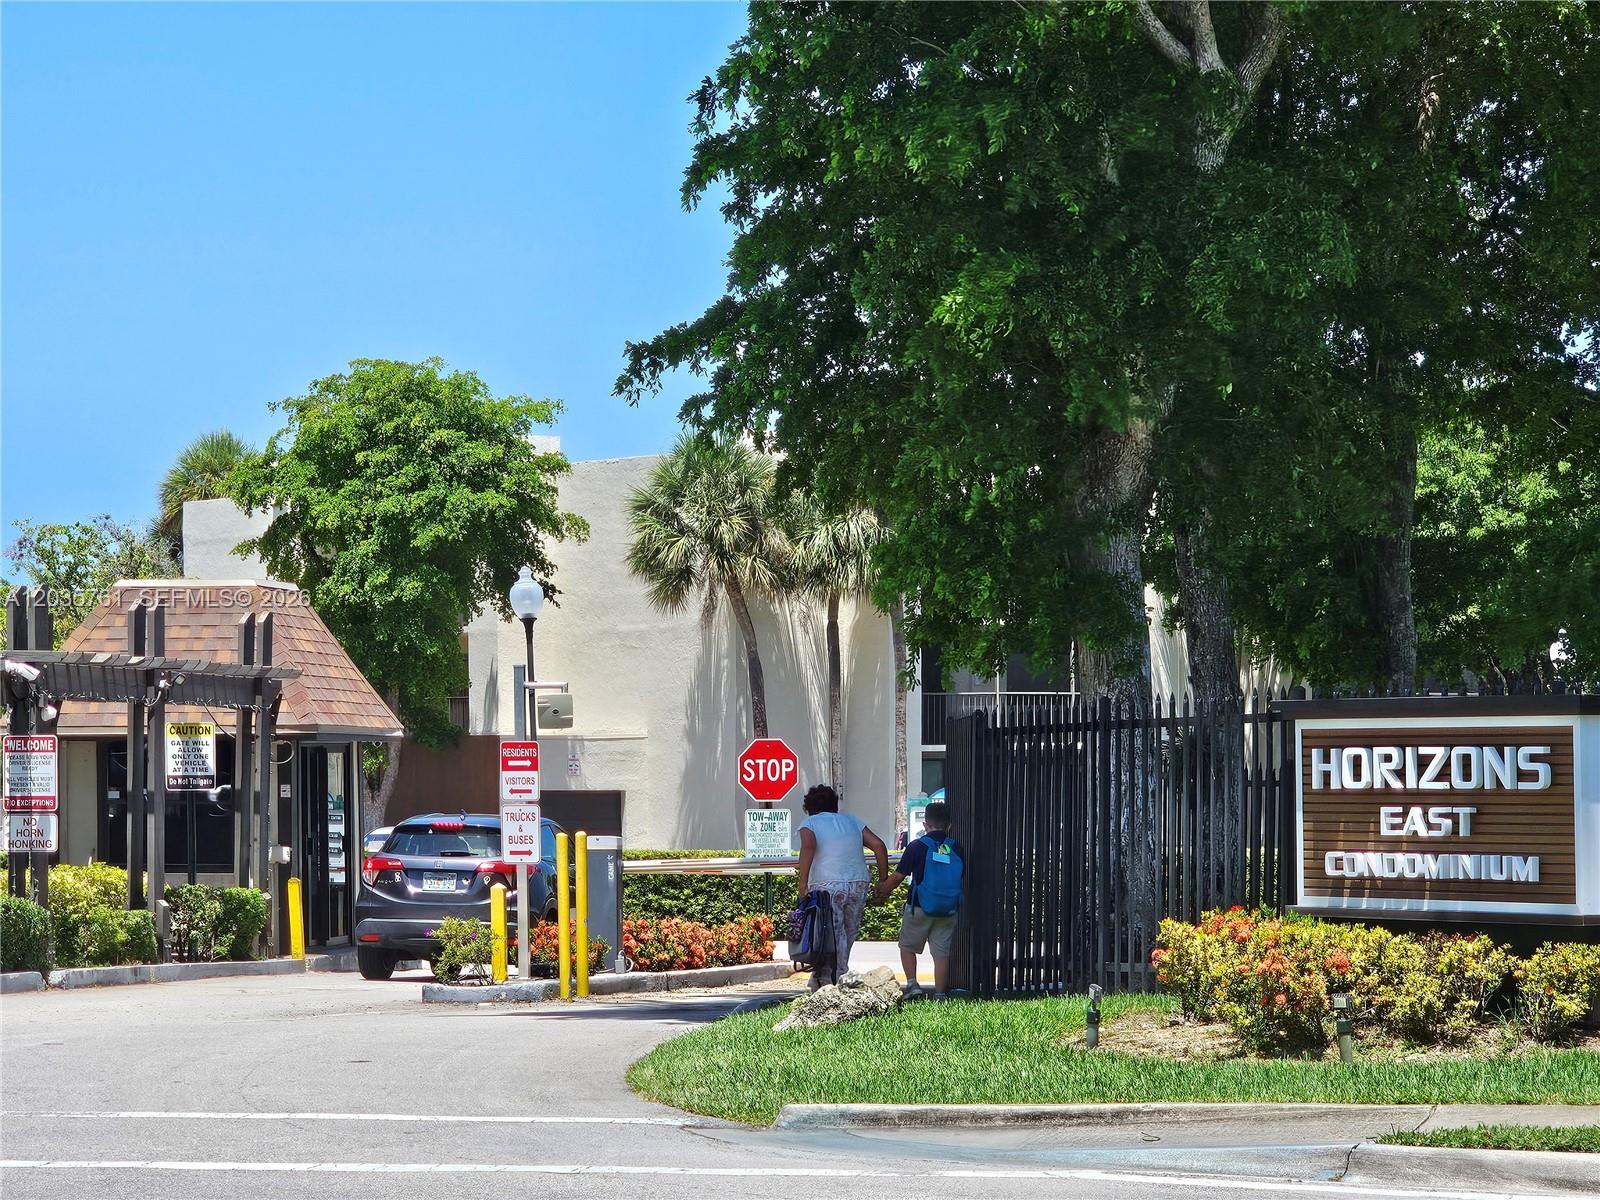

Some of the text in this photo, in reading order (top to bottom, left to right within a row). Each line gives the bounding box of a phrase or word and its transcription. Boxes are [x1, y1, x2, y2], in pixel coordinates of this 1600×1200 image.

[170, 726, 211, 735] CAUTION
[8, 740, 54, 750] WELCOME
[502, 748, 537, 757] RESIDENTS
[742, 758, 794, 782] STOP
[1311, 746, 1552, 791] HORIZONS
[190, 778, 212, 786] Tailgate
[504, 777, 536, 785] VISITORS
[505, 812, 536, 822] TRUCKS
[748, 812, 788, 821] TOW-AWAY
[23, 817, 37, 826] NO
[1380, 806, 1477, 837] EAST
[518, 825, 523, 833] &
[760, 823, 776, 832] ZONE
[16, 829, 44, 837] HORN
[8, 840, 52, 848] HONKING
[508, 835, 534, 845] BUSES
[1324, 850, 1540, 882] CONDOMINIUM
